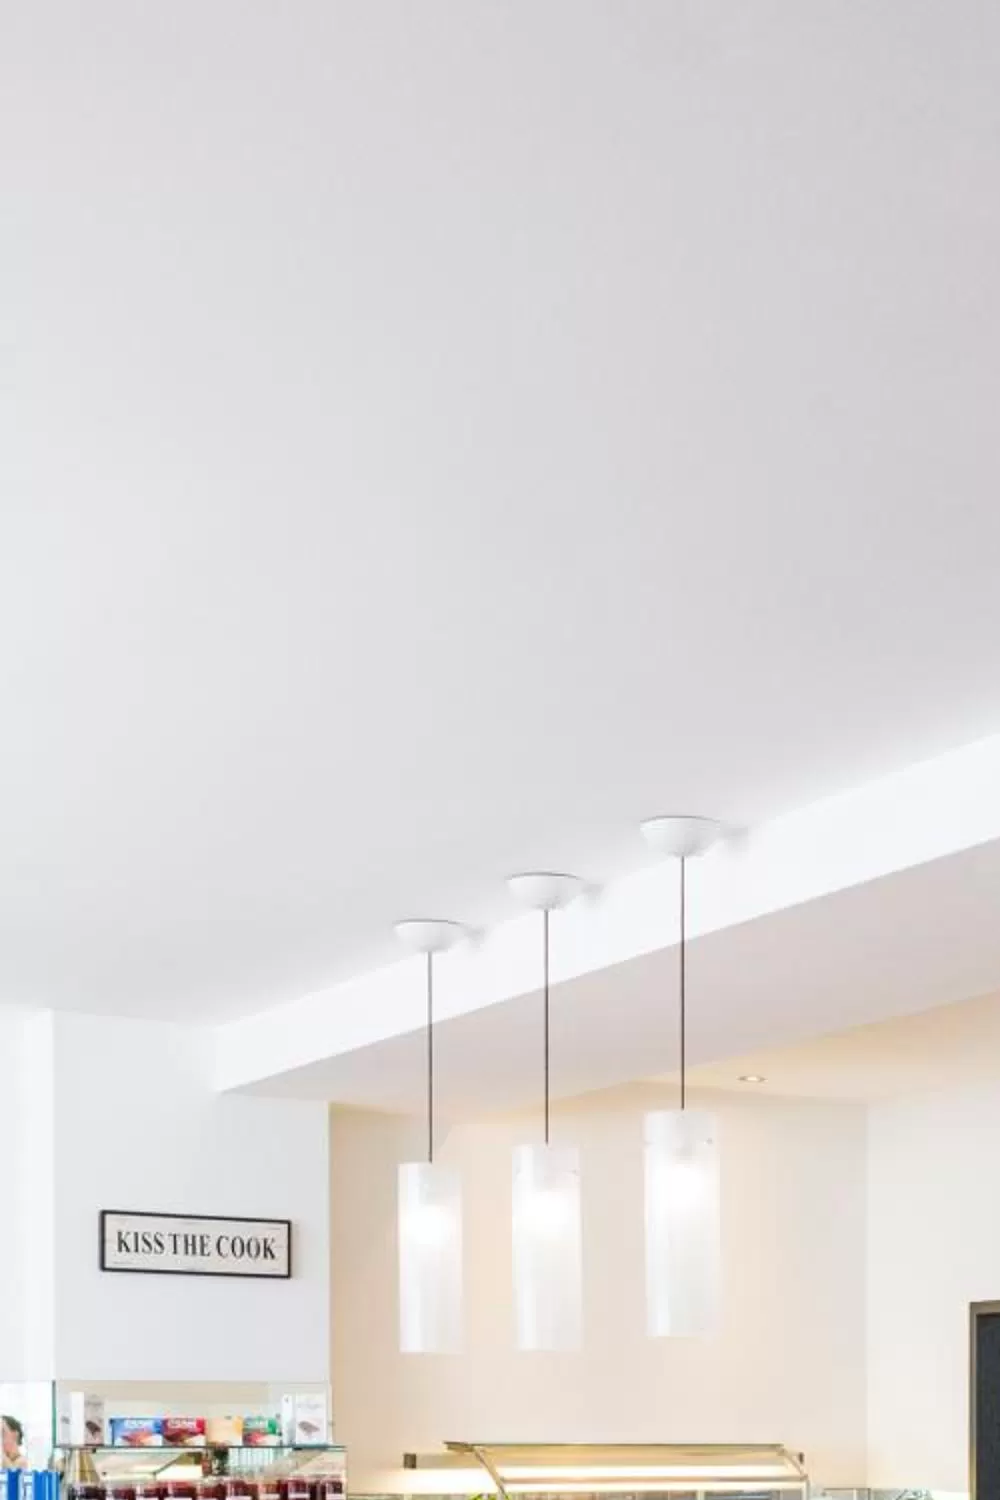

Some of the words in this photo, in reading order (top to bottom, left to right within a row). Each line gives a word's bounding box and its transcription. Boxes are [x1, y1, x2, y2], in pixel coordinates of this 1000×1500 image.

[116, 1230, 165, 1255] KISS
[168, 1233, 211, 1257] THE
[215, 1235, 277, 1260] COOK
